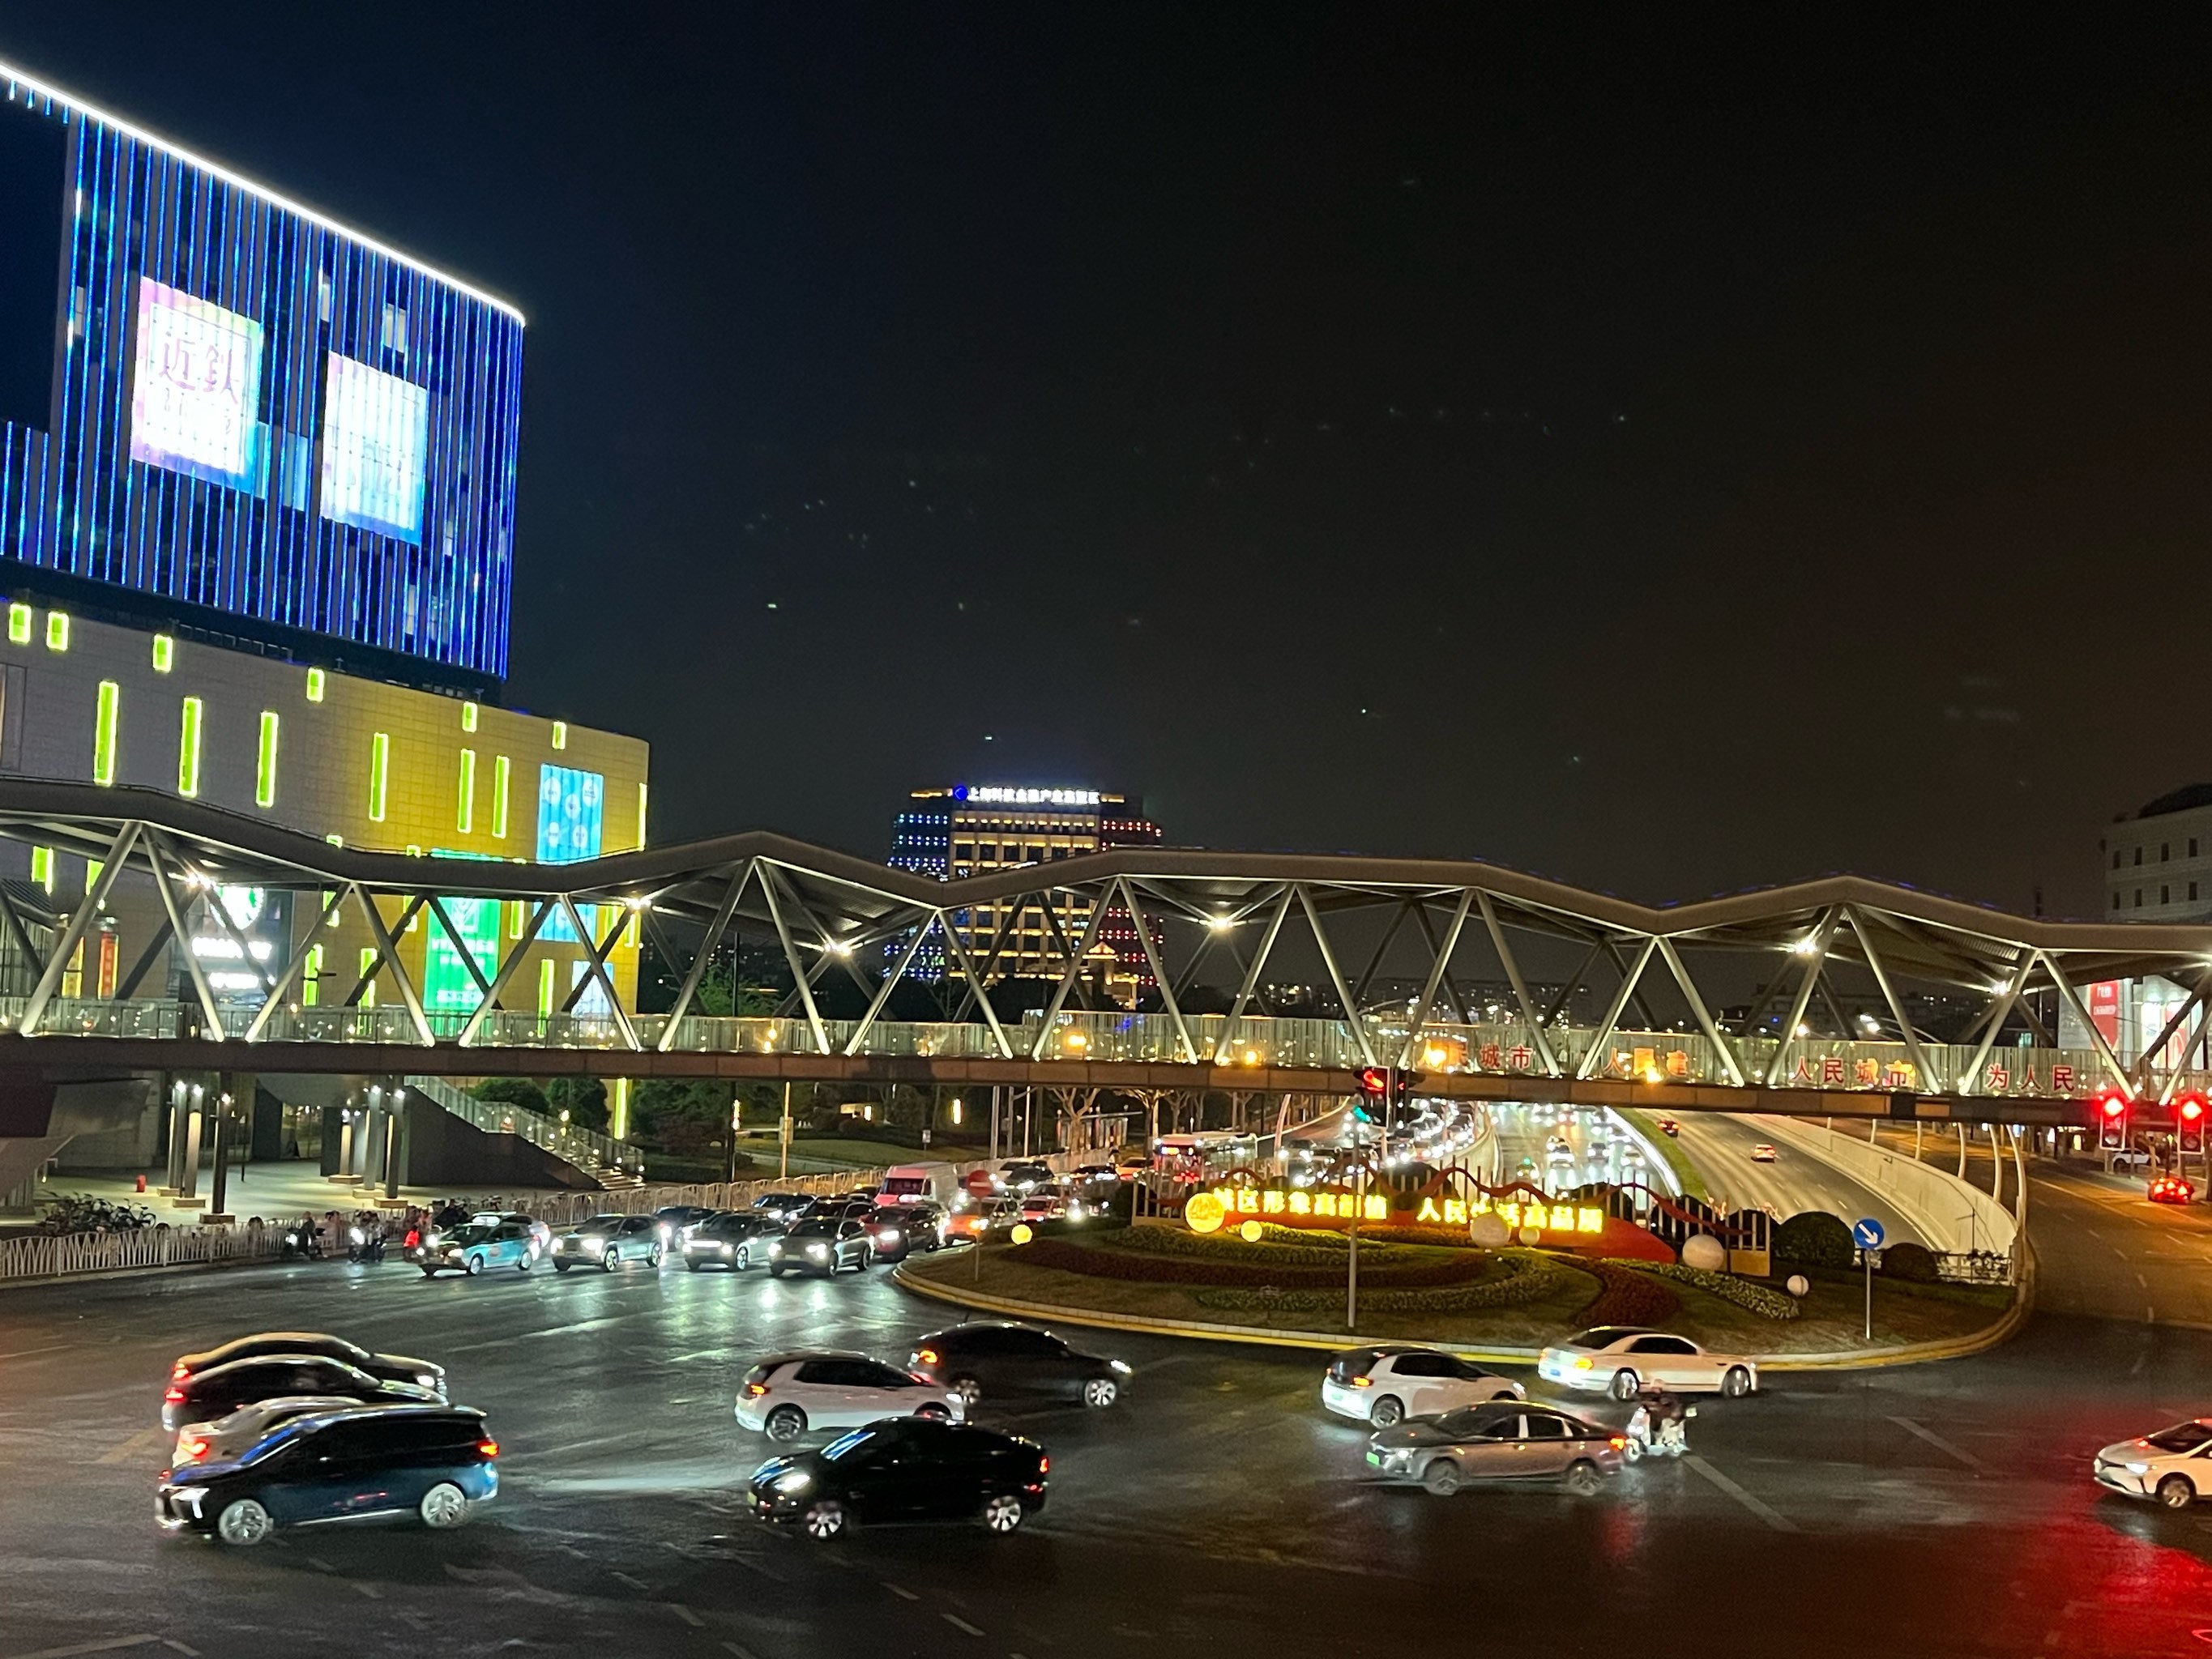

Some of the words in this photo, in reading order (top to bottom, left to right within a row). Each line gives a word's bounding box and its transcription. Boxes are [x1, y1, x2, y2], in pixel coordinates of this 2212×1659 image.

[1604, 1047, 1689, 1076] 人民建
[1791, 1056, 1915, 1087] 人民城市
[1987, 1063, 2076, 1092] 为人民
